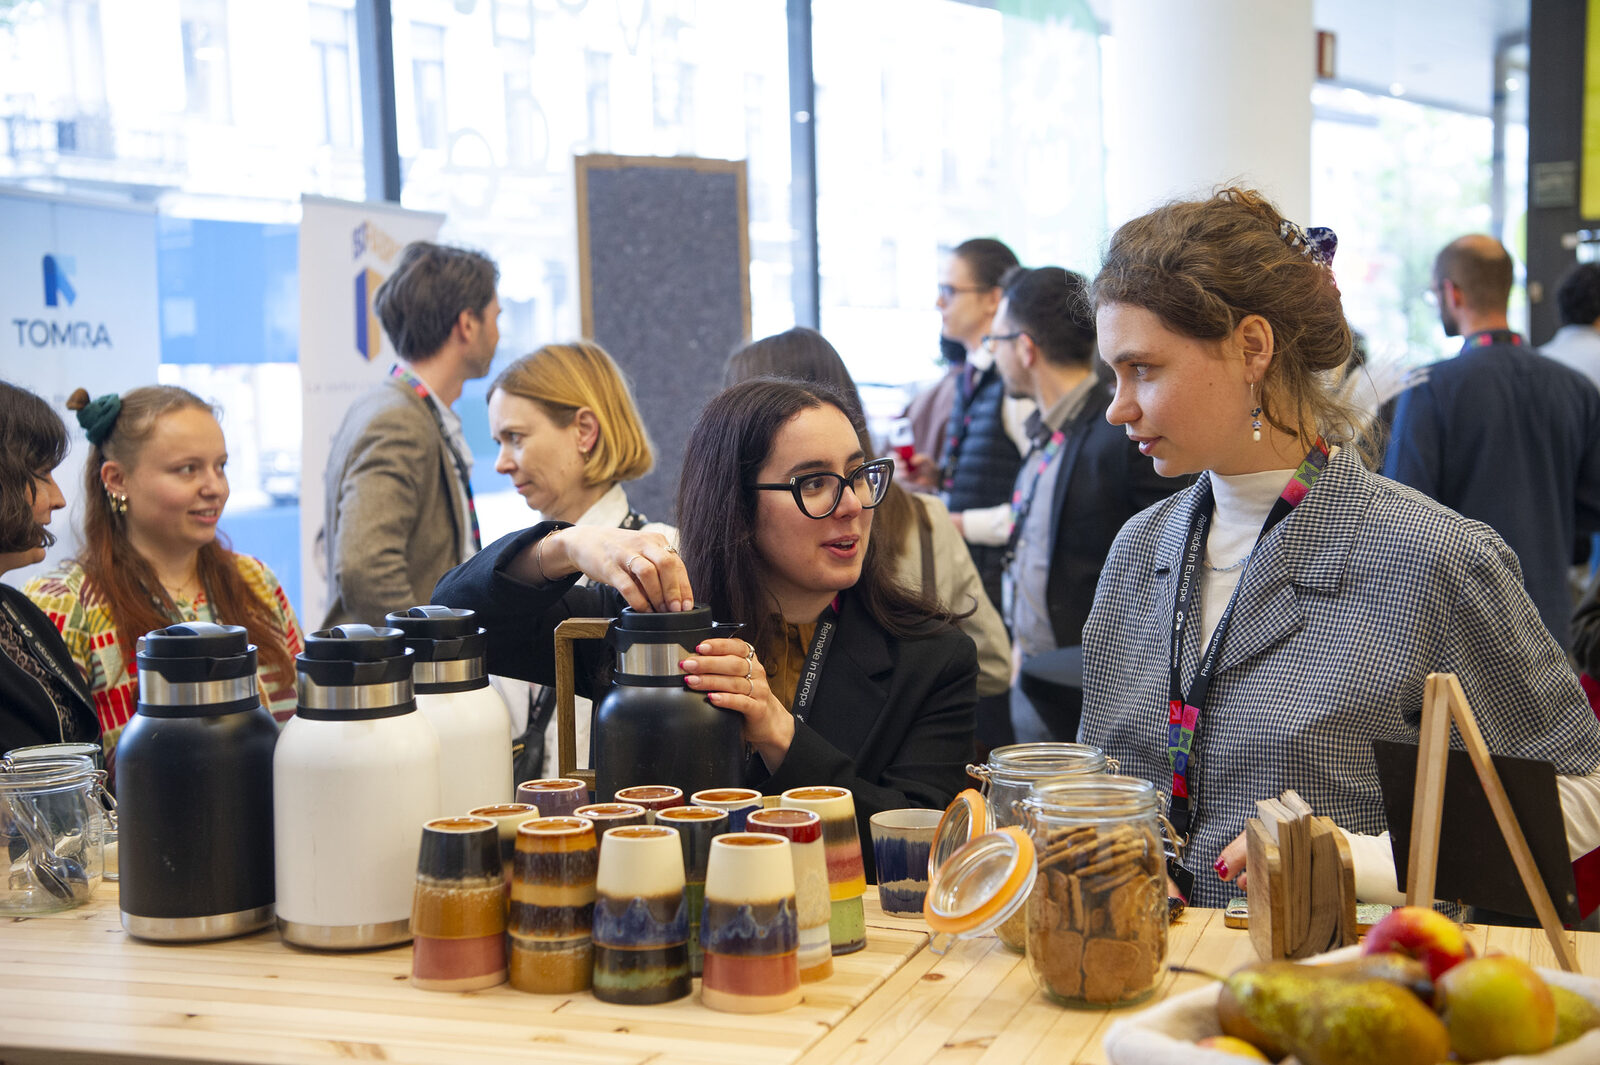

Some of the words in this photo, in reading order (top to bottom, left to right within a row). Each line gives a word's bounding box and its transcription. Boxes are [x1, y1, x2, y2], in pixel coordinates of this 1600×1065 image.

[12, 319, 113, 348] TOMRA
[1190, 513, 1207, 551] Remade
[1188, 551, 1199, 563] in
[1180, 563, 1195, 602] Europe
[812, 622, 832, 660] Remade
[1201, 632, 1221, 677] Remade
[809, 660, 820, 671] in
[798, 671, 816, 707] Europe
